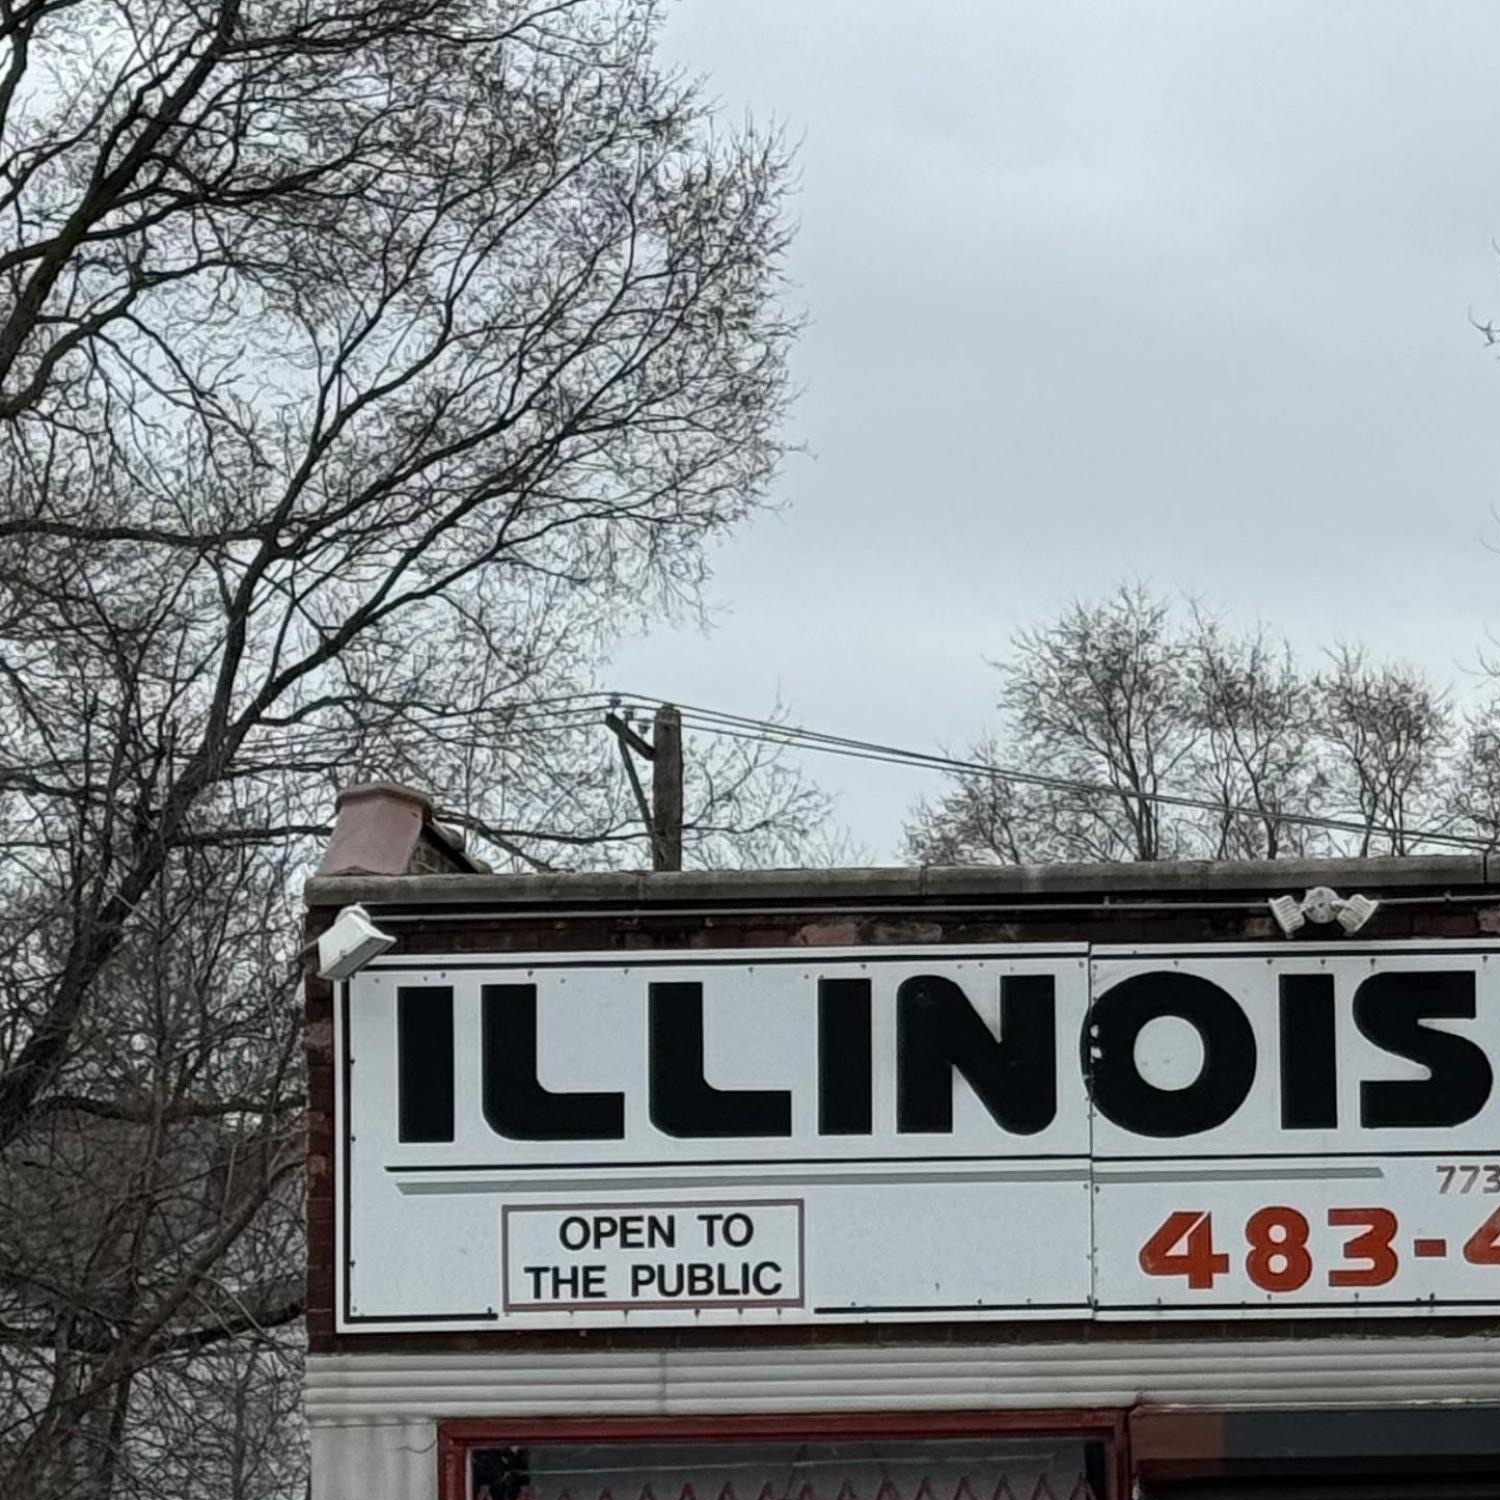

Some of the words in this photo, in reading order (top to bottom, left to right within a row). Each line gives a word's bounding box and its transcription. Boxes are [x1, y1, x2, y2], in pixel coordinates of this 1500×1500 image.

[397, 970, 1493, 1143] ILLINOIS
[559, 1216, 675, 1250] OPEN
[698, 1213, 753, 1248] TO
[524, 1266, 606, 1299] THE
[631, 1261, 782, 1297] PUBLIC
